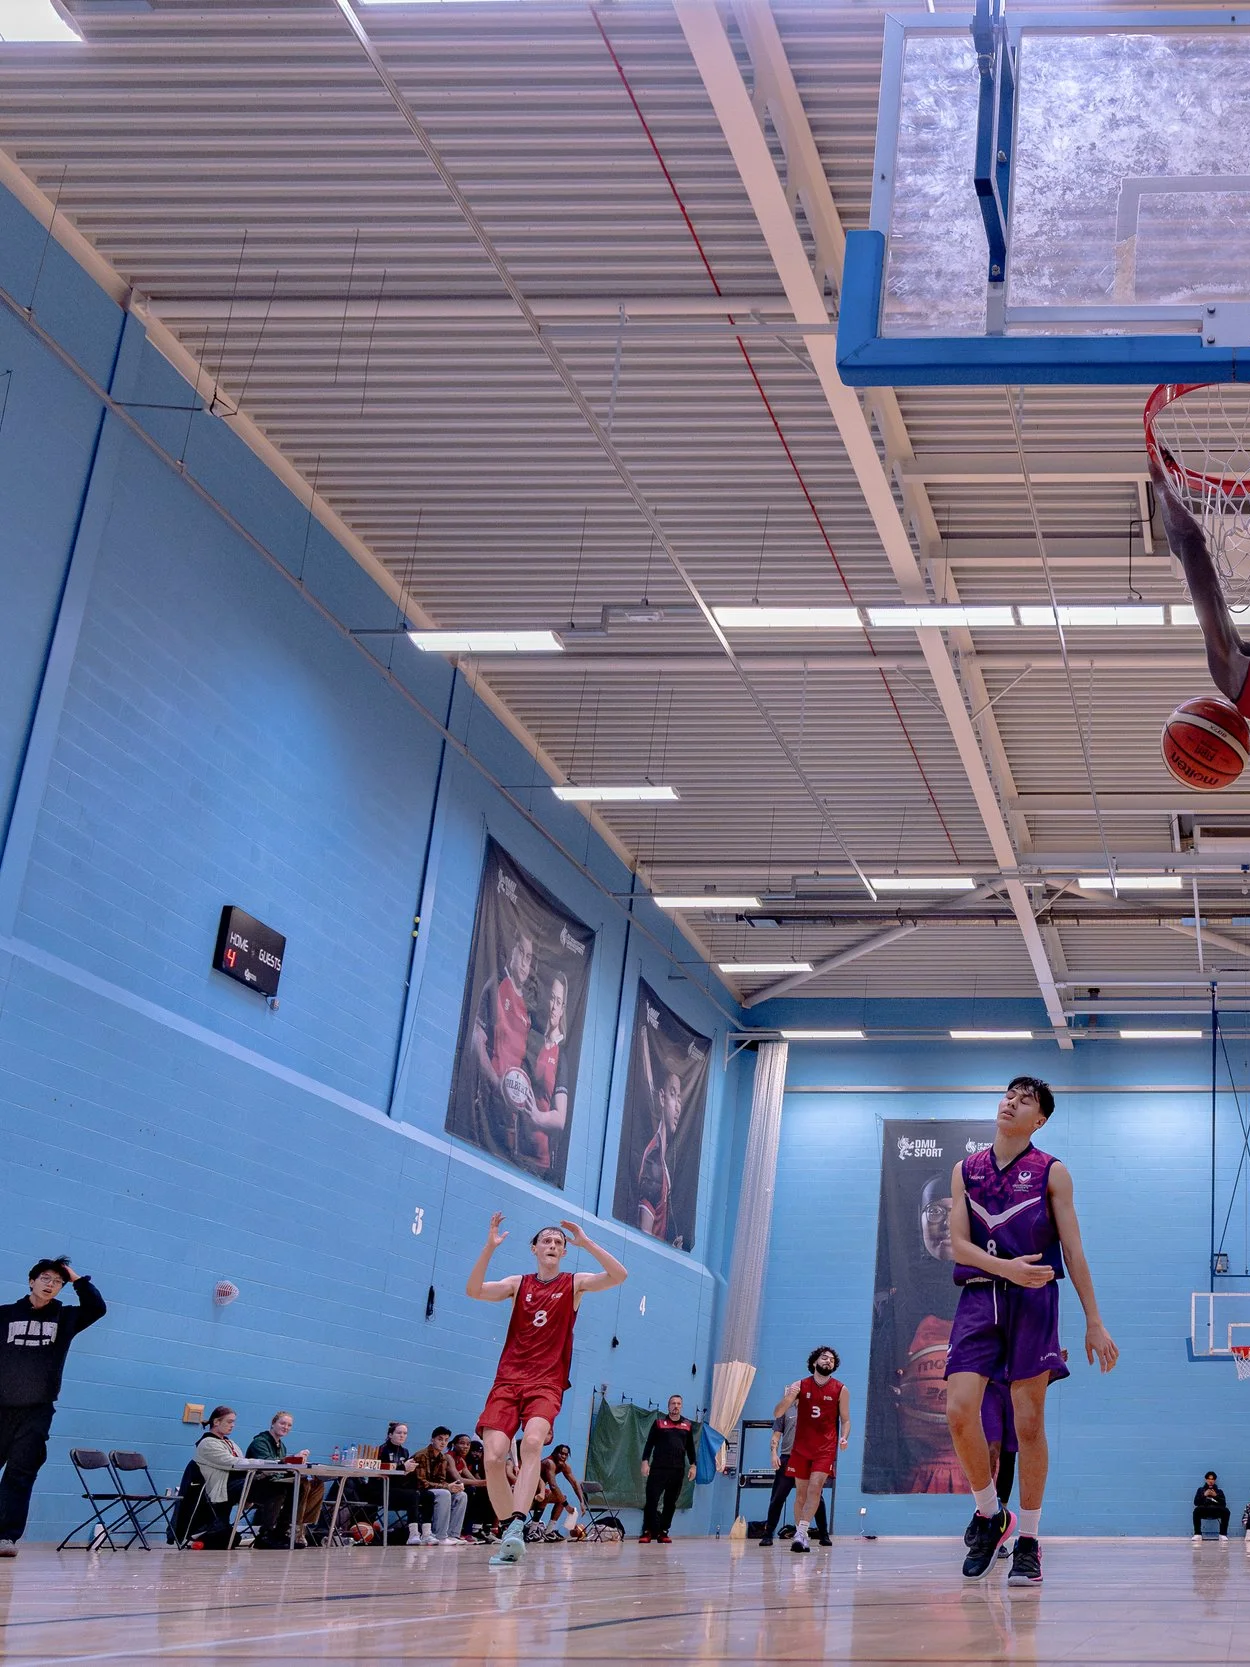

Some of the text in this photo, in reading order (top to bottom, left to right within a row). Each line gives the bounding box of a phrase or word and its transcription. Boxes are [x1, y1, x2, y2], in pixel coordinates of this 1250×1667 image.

[1171, 752, 1219, 785] molten
[226, 948, 237, 968] 4
[229, 931, 281, 971] HOME GUESTS
[914, 1148, 943, 1158] SPORT
[915, 1139, 936, 1148] DMU
[411, 1206, 425, 1236] 3
[986, 1239, 998, 1256] 8
[639, 1295, 646, 1316] 4
[532, 1309, 548, 1327] 8
[810, 1405, 821, 1418] 3
